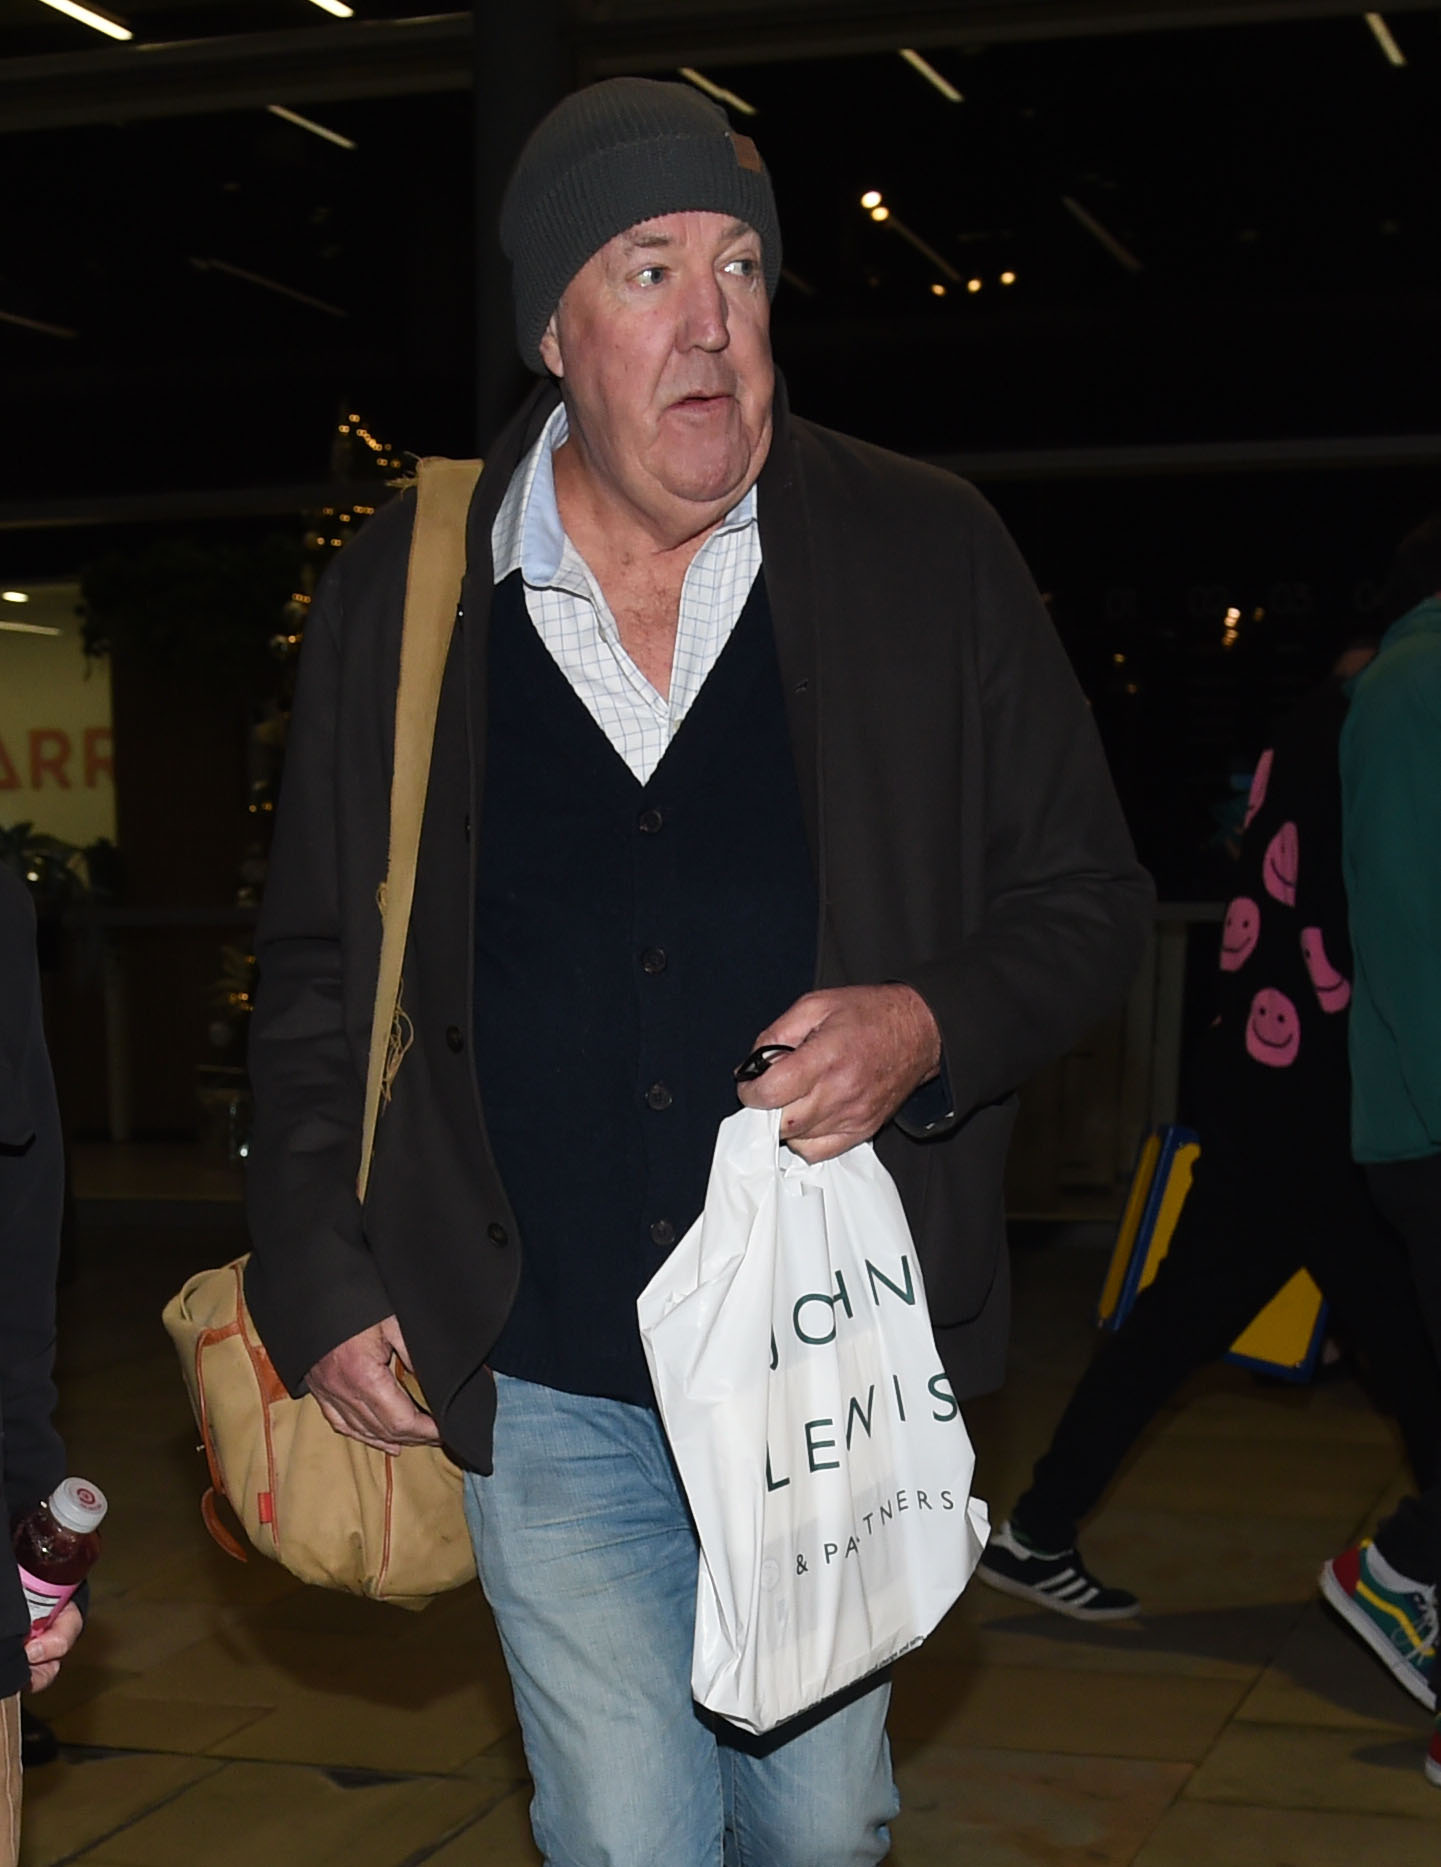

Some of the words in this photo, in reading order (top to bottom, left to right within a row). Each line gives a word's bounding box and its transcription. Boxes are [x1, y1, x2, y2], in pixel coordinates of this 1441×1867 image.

[770, 1254, 916, 1370] JOHN
[796, 1554, 809, 1575] &
[823, 1489, 954, 1565] PATNERS
